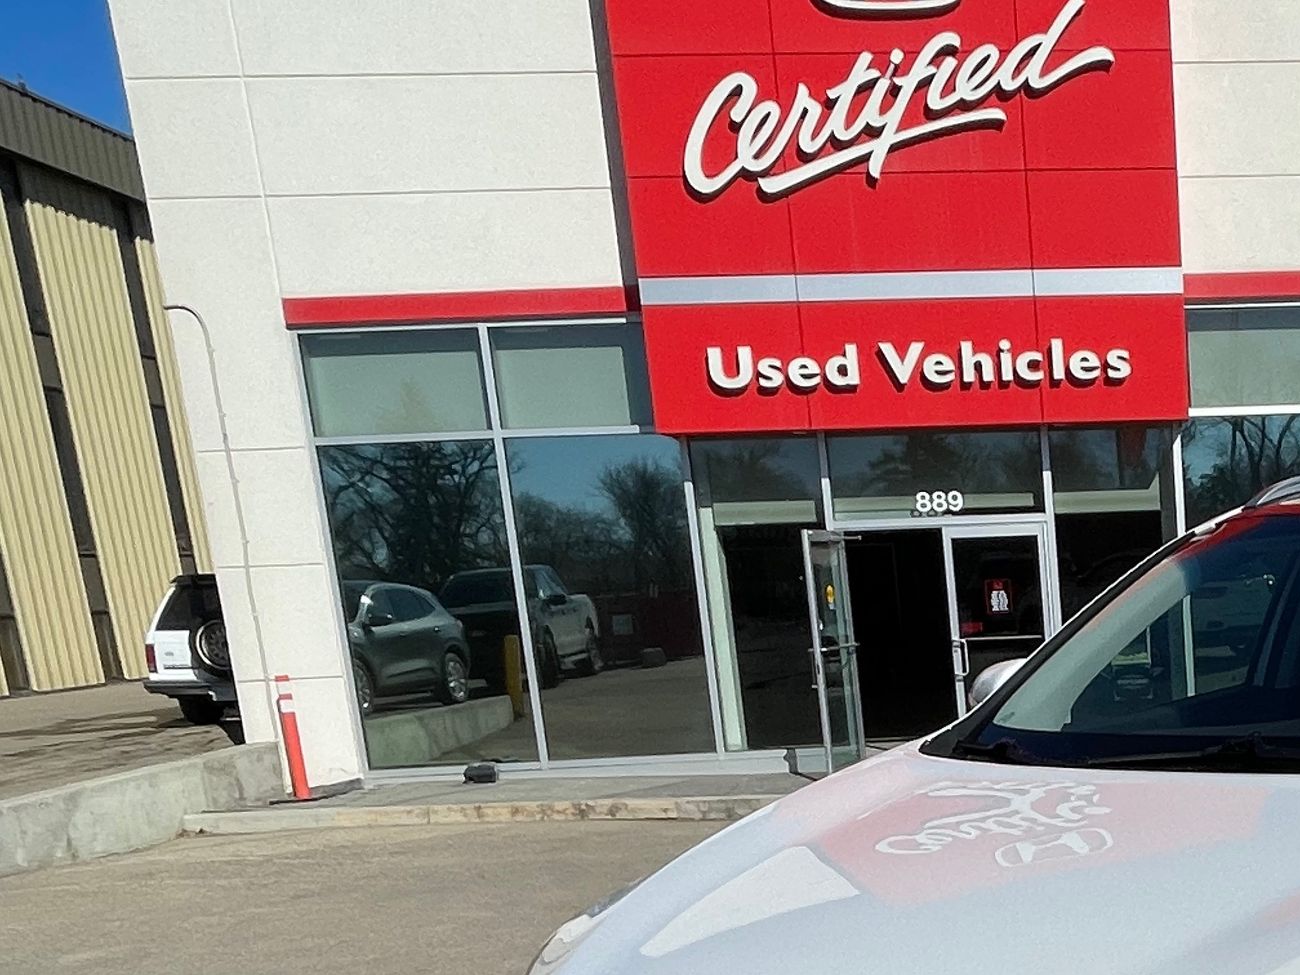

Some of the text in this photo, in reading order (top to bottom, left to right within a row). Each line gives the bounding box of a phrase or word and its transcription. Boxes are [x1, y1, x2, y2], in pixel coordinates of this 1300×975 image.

[682, 0, 1115, 196] Certified
[705, 337, 1133, 391] Used Vehicles
[915, 490, 964, 512] 889
